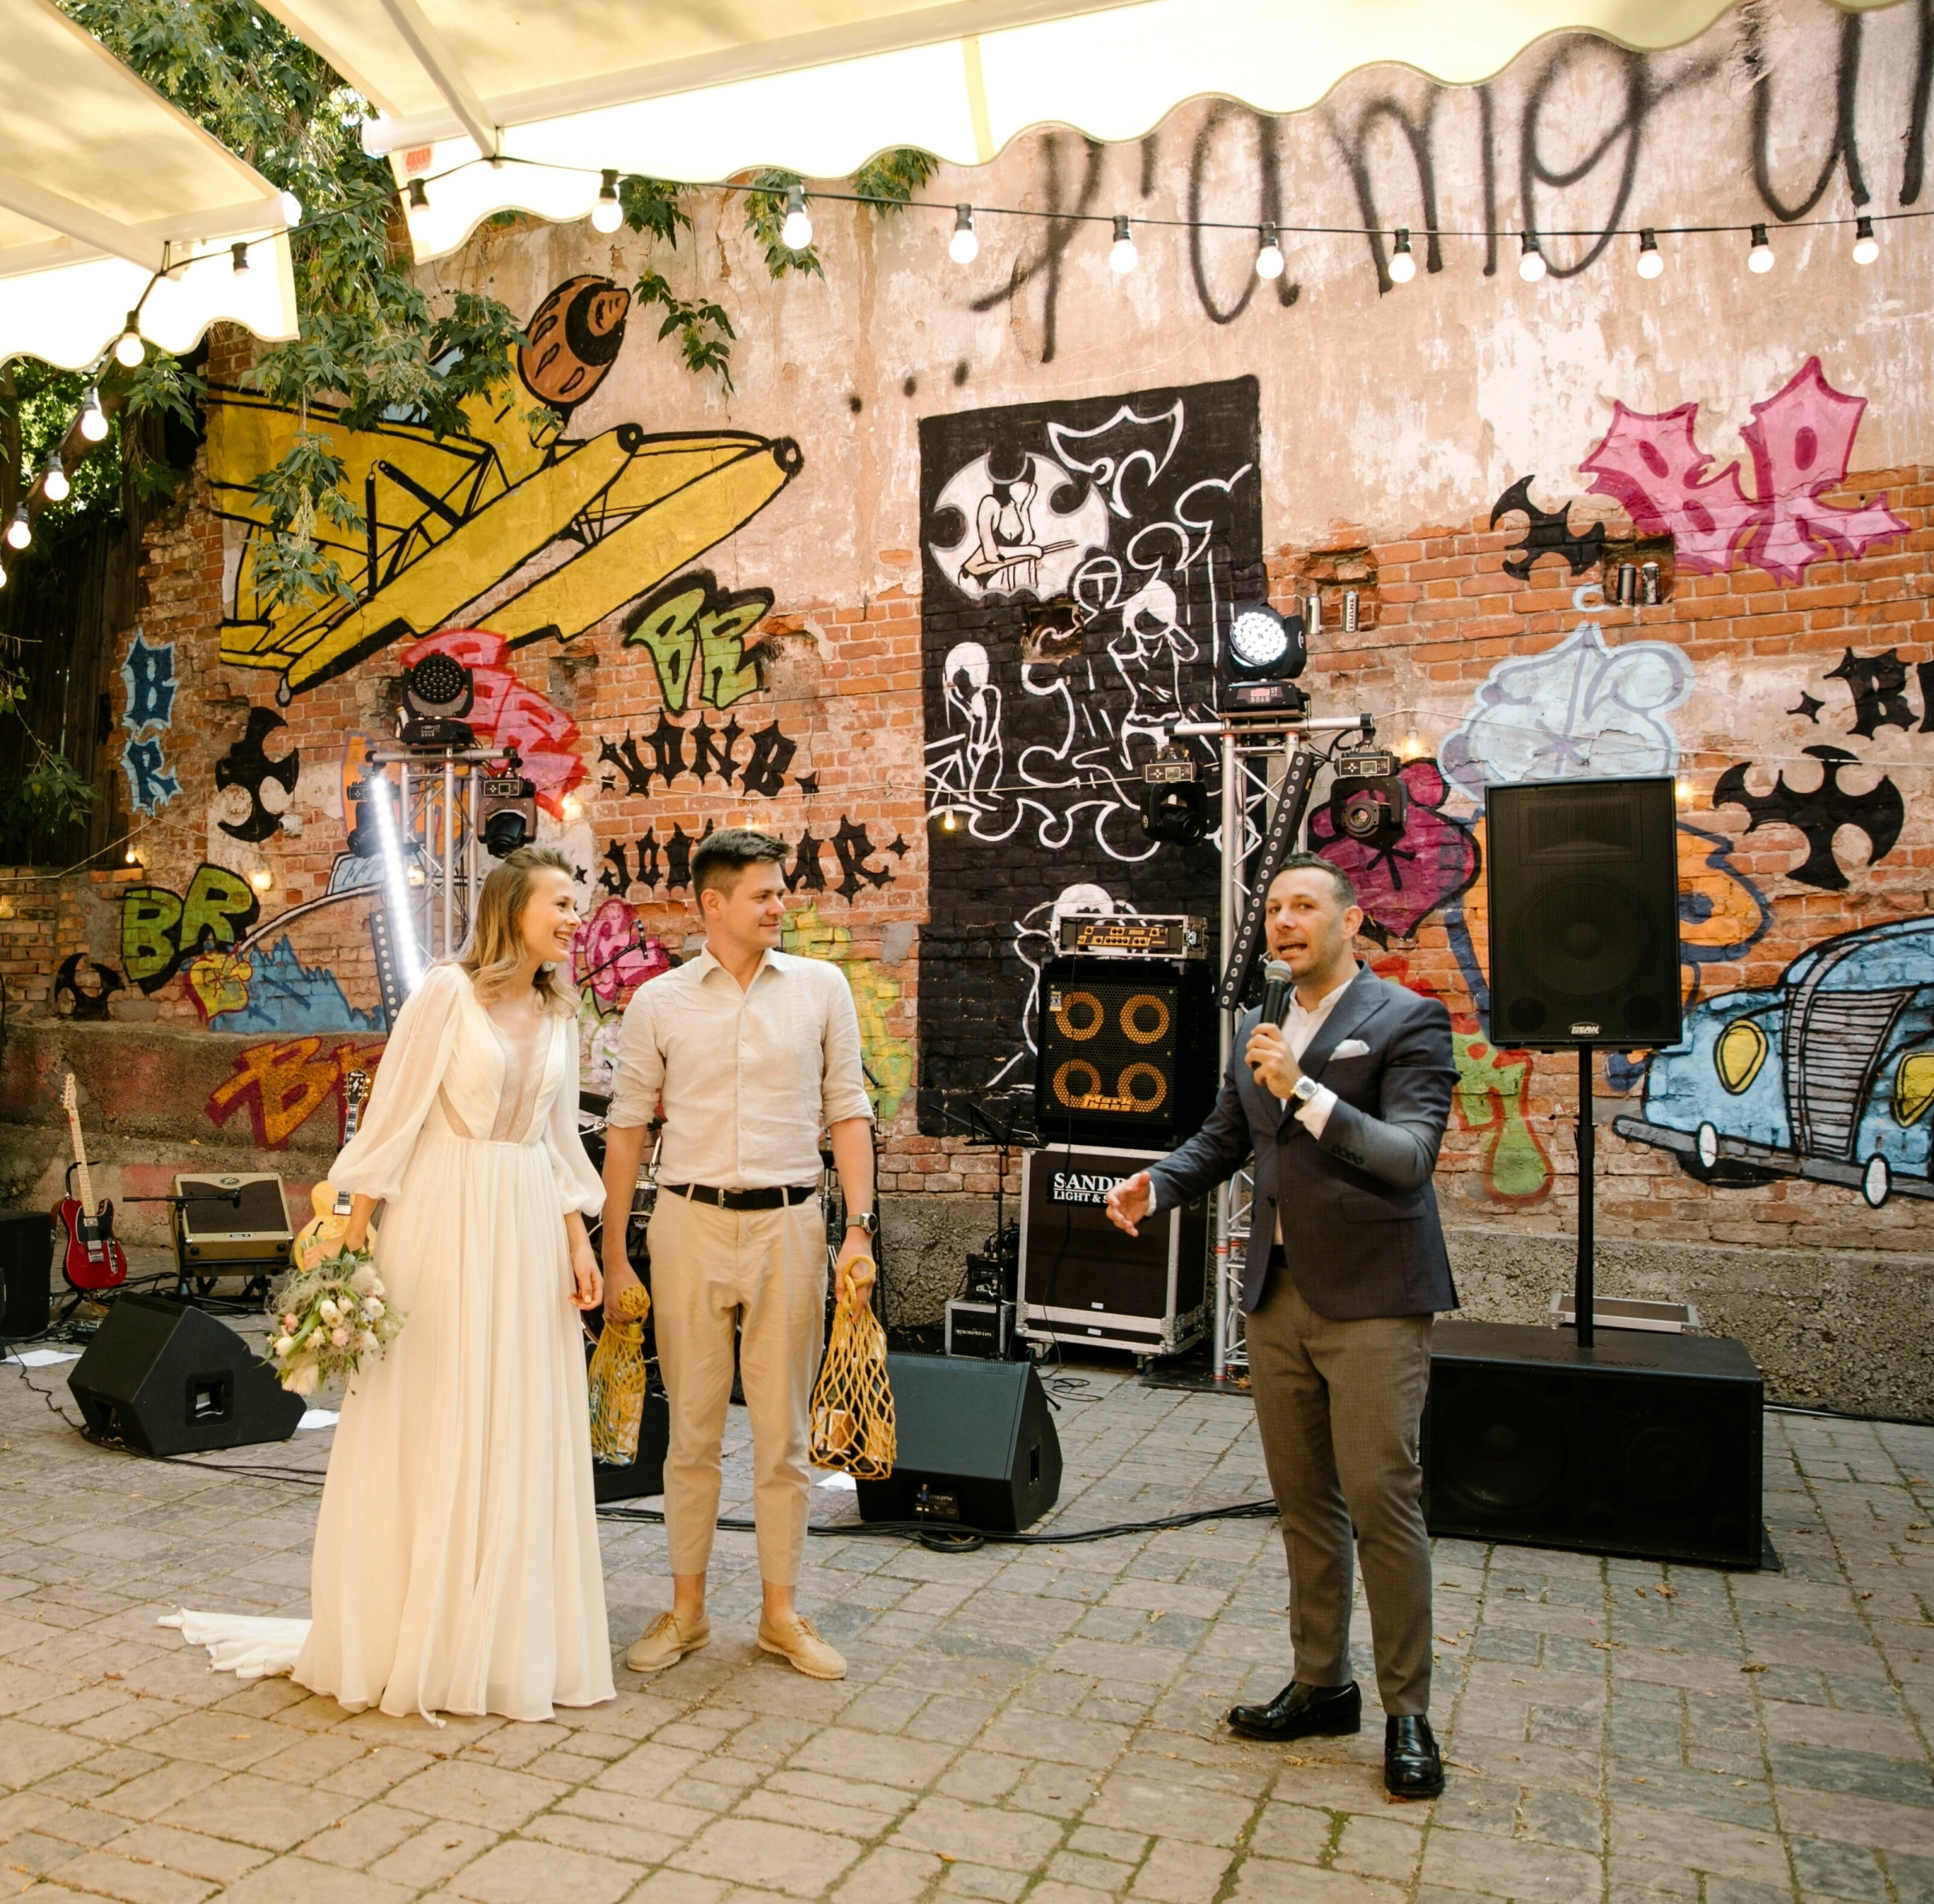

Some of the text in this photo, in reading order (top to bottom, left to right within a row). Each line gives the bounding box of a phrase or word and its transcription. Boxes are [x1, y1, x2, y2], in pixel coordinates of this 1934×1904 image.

[119, 862, 261, 996] BR
[1053, 1190, 1090, 1202] LIGHT
[1092, 1193, 1101, 1203] &
